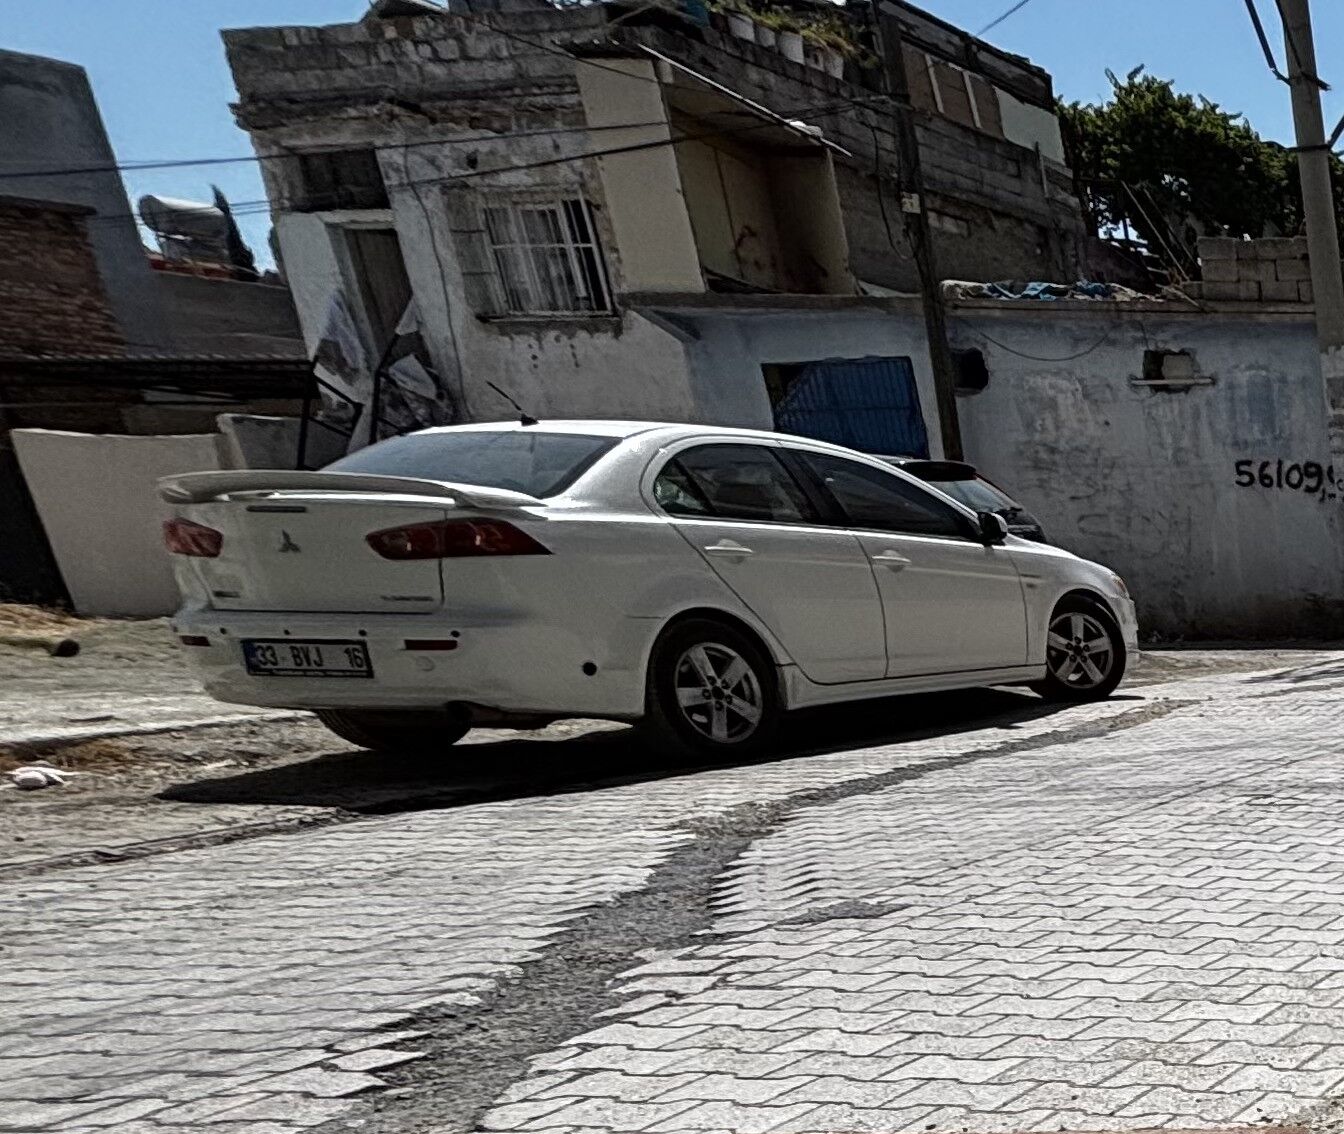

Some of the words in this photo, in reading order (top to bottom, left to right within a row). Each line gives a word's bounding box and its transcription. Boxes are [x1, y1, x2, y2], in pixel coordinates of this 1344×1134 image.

[255, 645, 279, 667] 33
[289, 645, 324, 668] BVJ
[343, 647, 364, 669] 16
